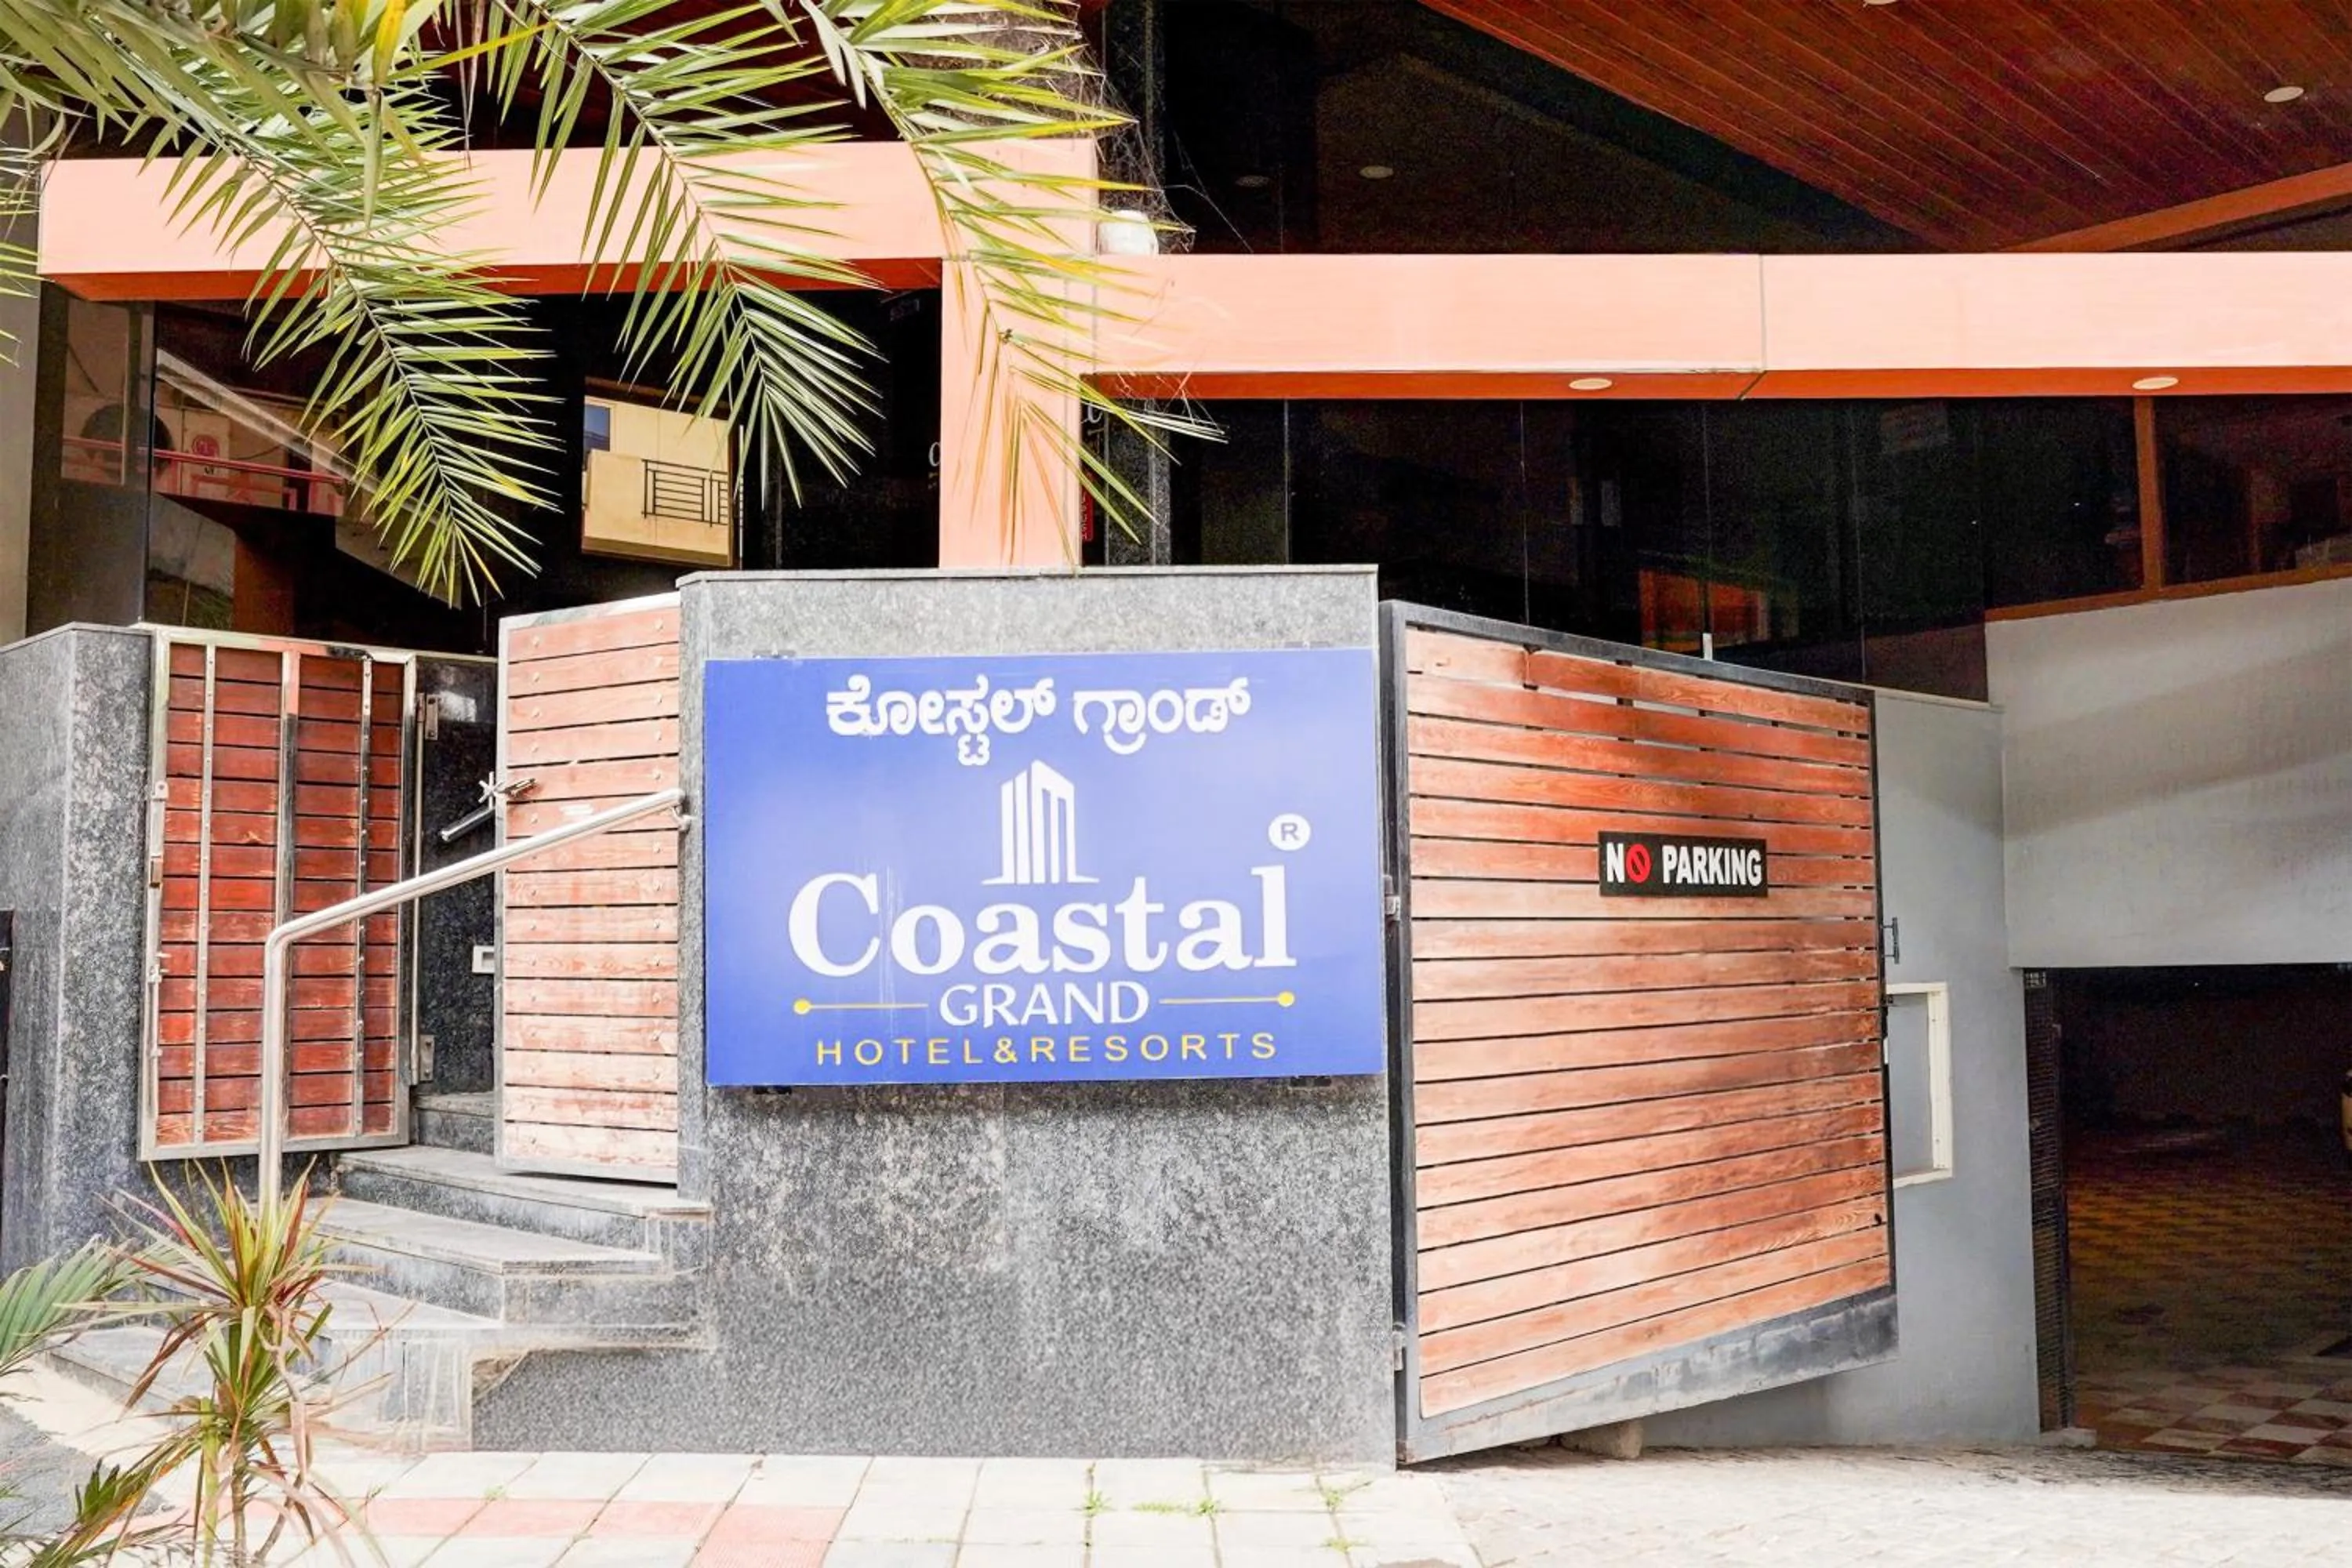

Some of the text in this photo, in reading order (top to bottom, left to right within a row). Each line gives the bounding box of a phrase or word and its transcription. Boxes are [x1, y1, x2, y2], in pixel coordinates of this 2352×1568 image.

[826, 674, 1252, 766] ಕೋಸ್ಟಲ್ ಗ್ರಾಂಡ್
[1661, 844, 1762, 887] PARKING
[788, 864, 1298, 977] Coastal
[938, 980, 1149, 1028] GRAND
